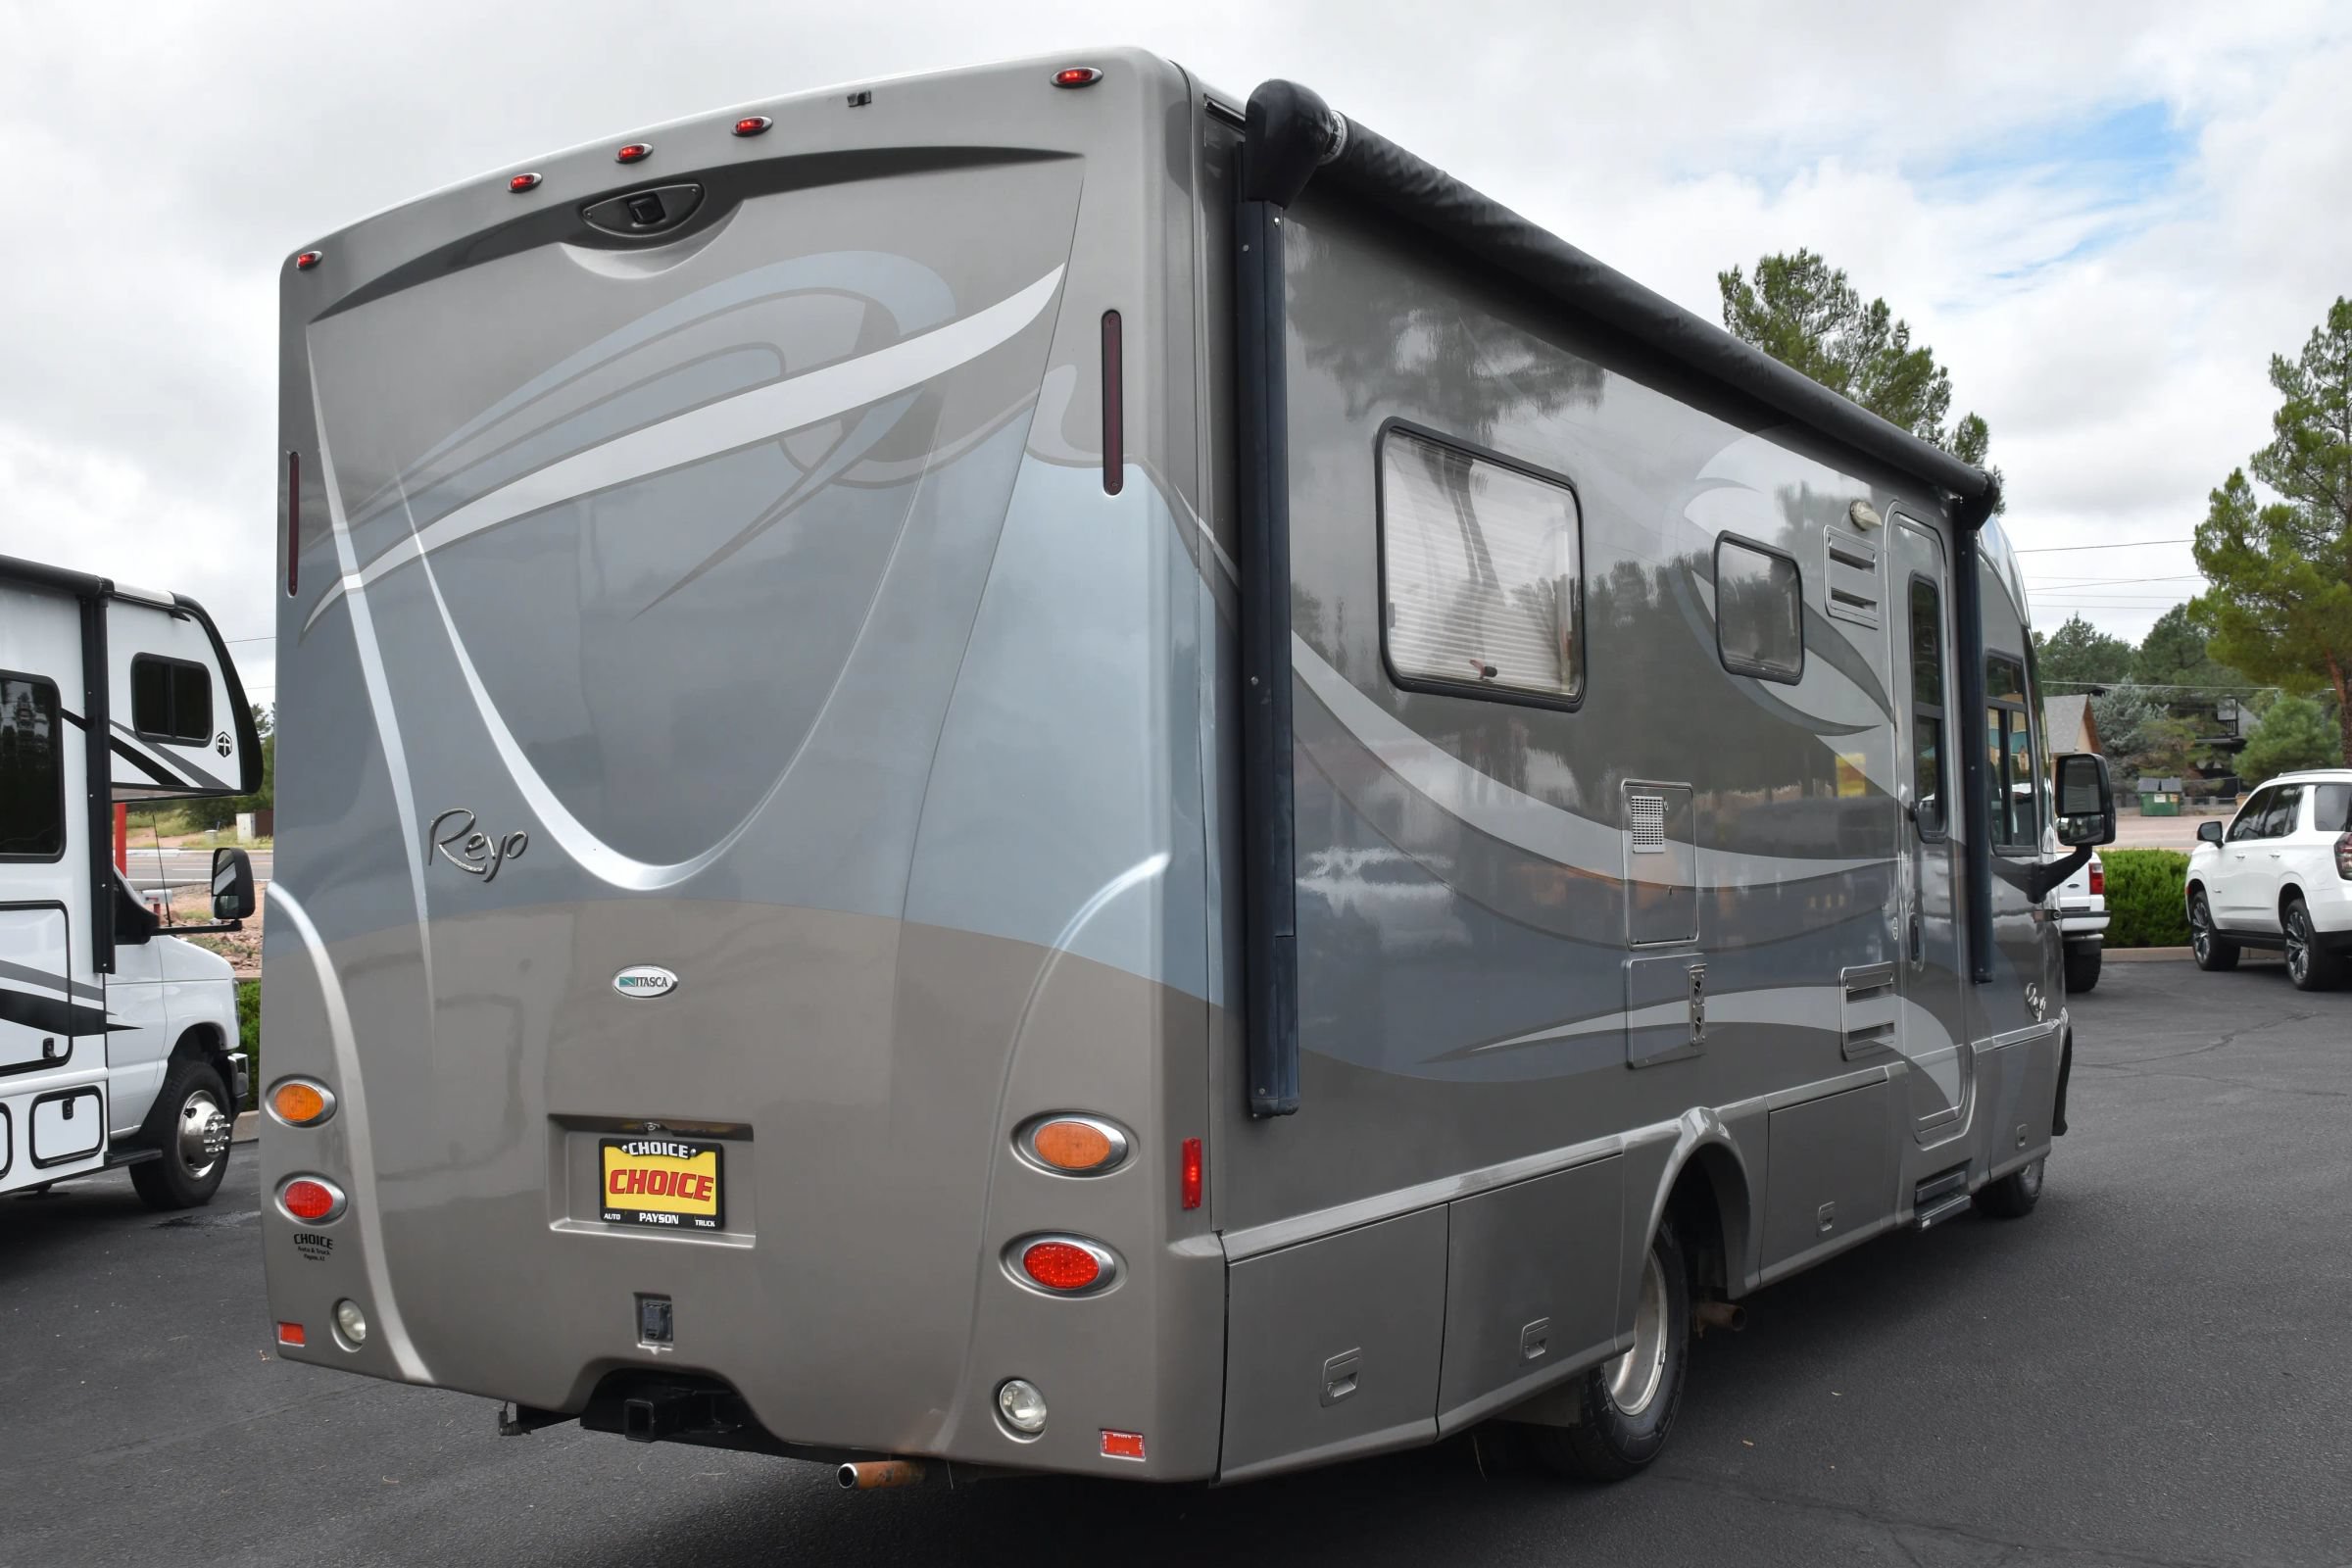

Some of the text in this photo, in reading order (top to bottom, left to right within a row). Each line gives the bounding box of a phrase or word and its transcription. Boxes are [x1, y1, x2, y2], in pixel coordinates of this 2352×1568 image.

[428, 808, 529, 883] Reyo
[635, 976, 668, 988] ITASCA
[628, 1142, 688, 1158] CHOICE
[609, 1169, 713, 1201] CHOICE
[604, 1212, 715, 1227] AUTO PAYSON TRUCK
[293, 1233, 333, 1250] CHOICE
